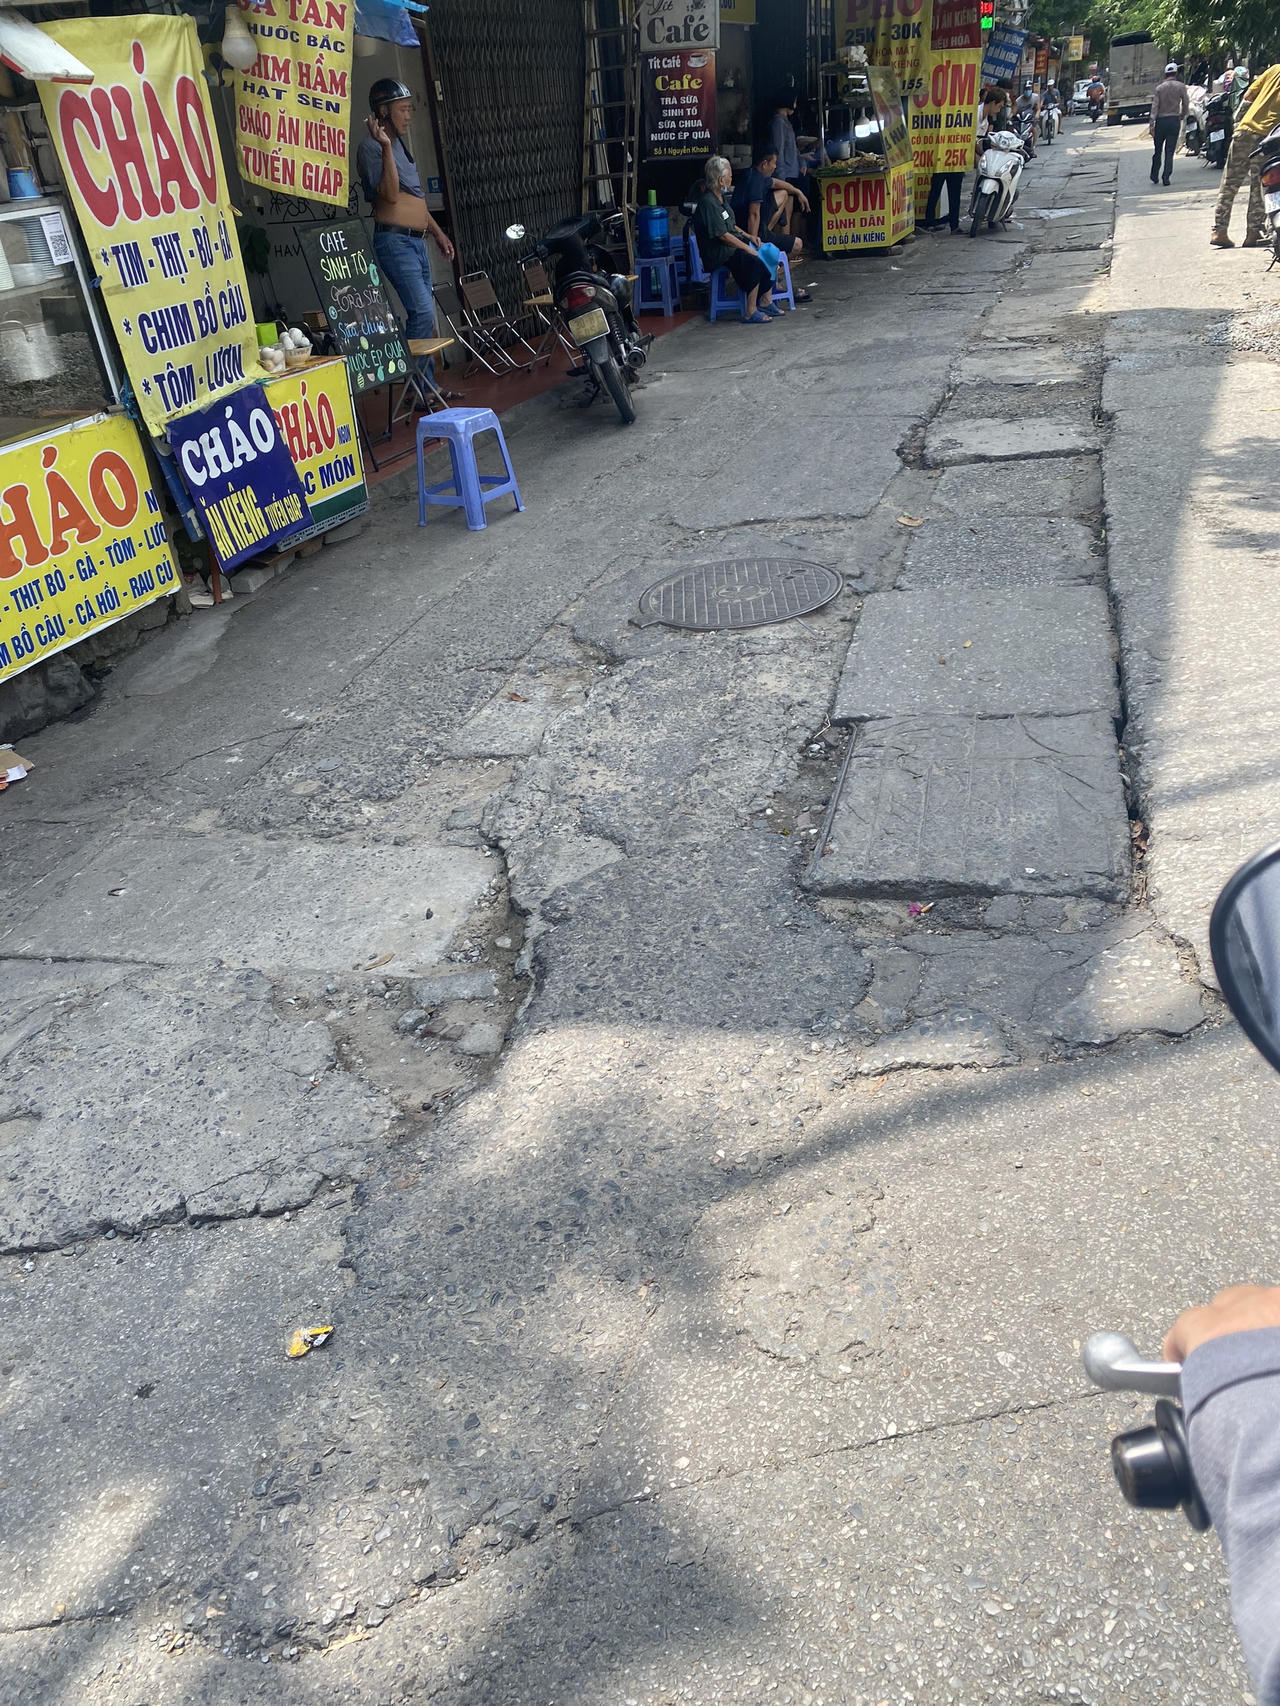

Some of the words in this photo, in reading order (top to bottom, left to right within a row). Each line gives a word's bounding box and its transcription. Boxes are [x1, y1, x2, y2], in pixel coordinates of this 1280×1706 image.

[248, 23, 300, 43] HUỐC
[307, 34, 346, 53] BẮC
[647, 14, 710, 44] Café
[891, 22, 922, 40] 30K
[241, 52, 291, 85] HIM
[297, 53, 347, 98] HẦM
[655, 74, 703, 91] Cafe
[243, 81, 287, 100] HẠT
[298, 93, 340, 114] SEN
[660, 96, 677, 105] TRÀ
[662, 108, 683, 117] SINH
[686, 105, 698, 116] TỐ
[60, 40, 218, 227] CHÁO
[239, 104, 271, 140] CHÁO
[277, 108, 299, 146] ĂN
[305, 118, 346, 158] KIÊNG
[679, 119, 703, 129] CHUA
[912, 111, 941, 130] BÌNH
[945, 110, 973, 128] DÂN
[243, 145, 295, 187] TUYẾN
[302, 161, 343, 197] GIÁP
[913, 150, 933, 168] 20K
[944, 149, 967, 166] 25K
[826, 178, 885, 215] CƠM
[860, 215, 885, 228] DÂN
[111, 242, 148, 287] TIM
[152, 232, 189, 284] THỊT
[192, 217, 214, 269] BÒ
[218, 210, 233, 261] GÀ
[320, 230, 348, 252] CAFE
[351, 249, 368, 275] TỐ
[138, 303, 195, 354] CHIM
[195, 282, 218, 340] BỒ
[219, 280, 247, 329] CÂU
[154, 357, 197, 412] TÔM
[204, 344, 246, 392] LƯƠN
[271, 381, 336, 464] HÁO
[182, 406, 275, 486] CHÁO
[319, 454, 355, 490] MÓN
[0, 445, 139, 579] HÁO
[200, 496, 237, 561] ĂN
[220, 482, 270, 550] KIÊNG
[10, 579, 44, 612] THỊT
[44, 564, 67, 597] BÒ
[76, 551, 98, 581] GÀ
[105, 536, 137, 567] TÔM
[11, 622, 34, 659] BỒ
[34, 613, 67, 647] CÂU
[75, 596, 97, 626] CÁ
[96, 582, 121, 614] HỒI
[128, 569, 154, 600] RAU
[156, 553, 174, 584] CỦ
